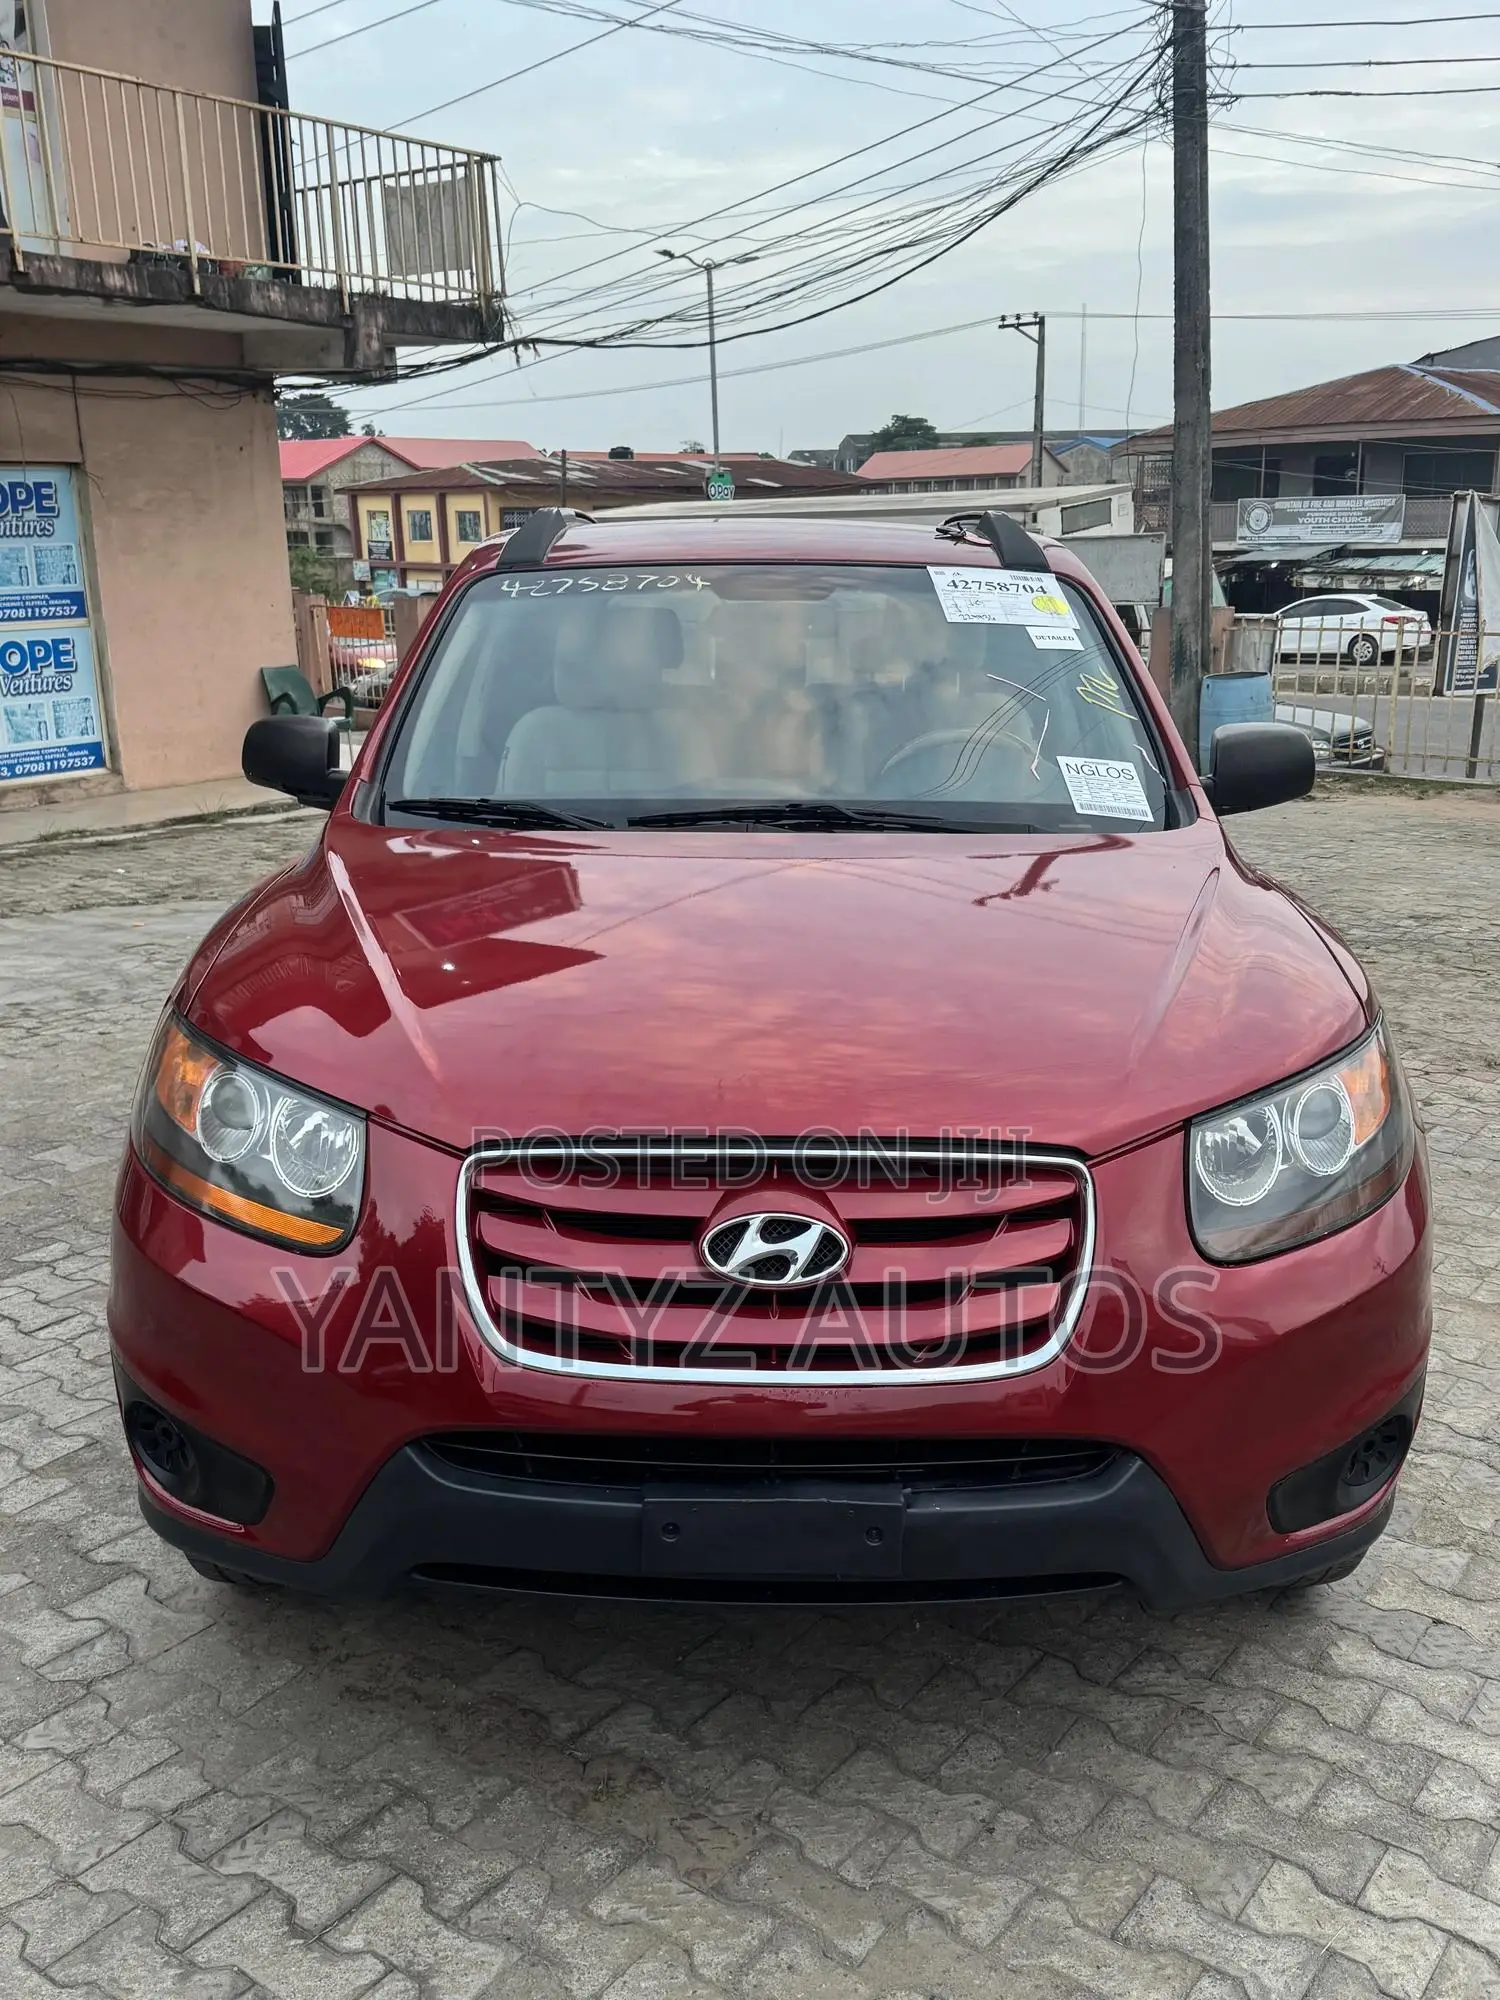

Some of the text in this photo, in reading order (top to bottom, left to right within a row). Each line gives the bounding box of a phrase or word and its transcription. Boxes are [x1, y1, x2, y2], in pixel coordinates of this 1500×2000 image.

[1298, 516, 1330, 524] YOUTH
[946, 579, 1048, 595] 42758704
[1034, 634, 1075, 642] DETAILED
[1, 674, 72, 697] Ventures
[15, 756, 96, 774] 07081197537
[1065, 763, 1134, 780] NGLOS
